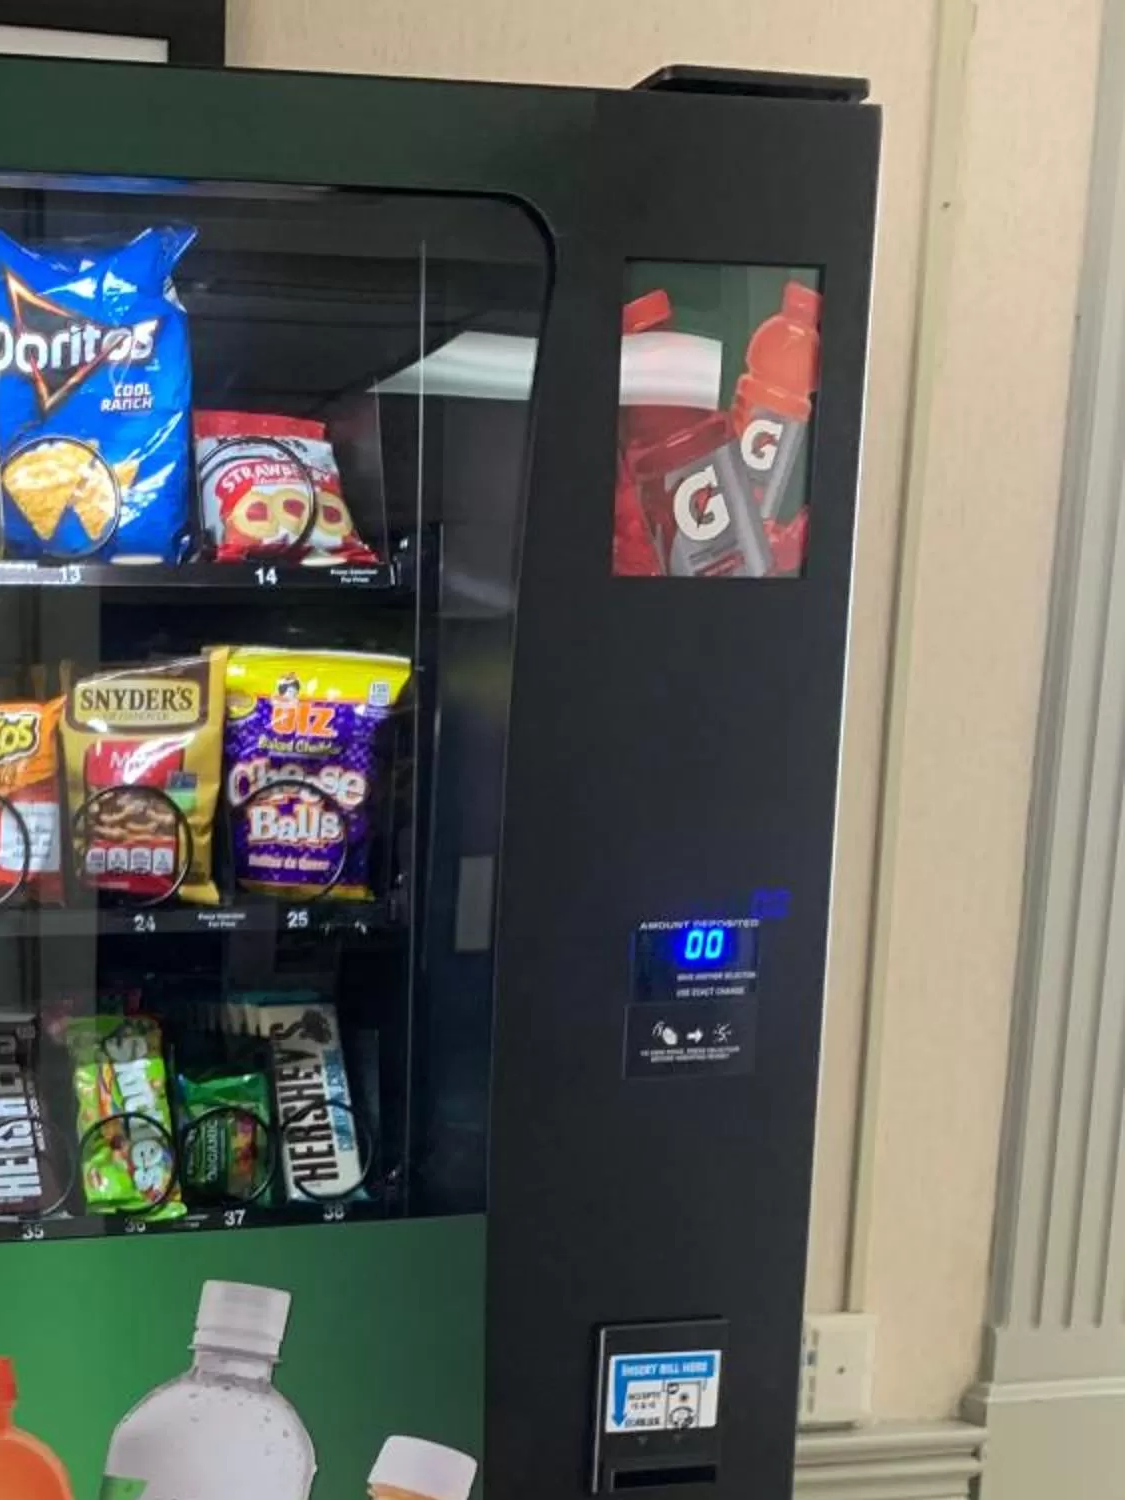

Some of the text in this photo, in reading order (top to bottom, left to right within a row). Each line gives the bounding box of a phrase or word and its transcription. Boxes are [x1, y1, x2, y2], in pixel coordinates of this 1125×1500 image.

[113, 383, 152, 398] COOL
[100, 398, 153, 412] RANCH
[741, 418, 784, 472] G
[673, 464, 731, 542] G
[60, 565, 81, 583] 13
[254, 567, 278, 585] 14
[79, 686, 193, 712] SNYDER'S
[248, 801, 343, 845] Balls
[134, 913, 156, 932] 24
[286, 911, 309, 929] 25
[639, 920, 689, 931] AMOUNT
[684, 928, 724, 960] 00
[224, 1209, 247, 1226] 37
[323, 1203, 345, 1221] 38
[22, 1223, 45, 1240] 35
